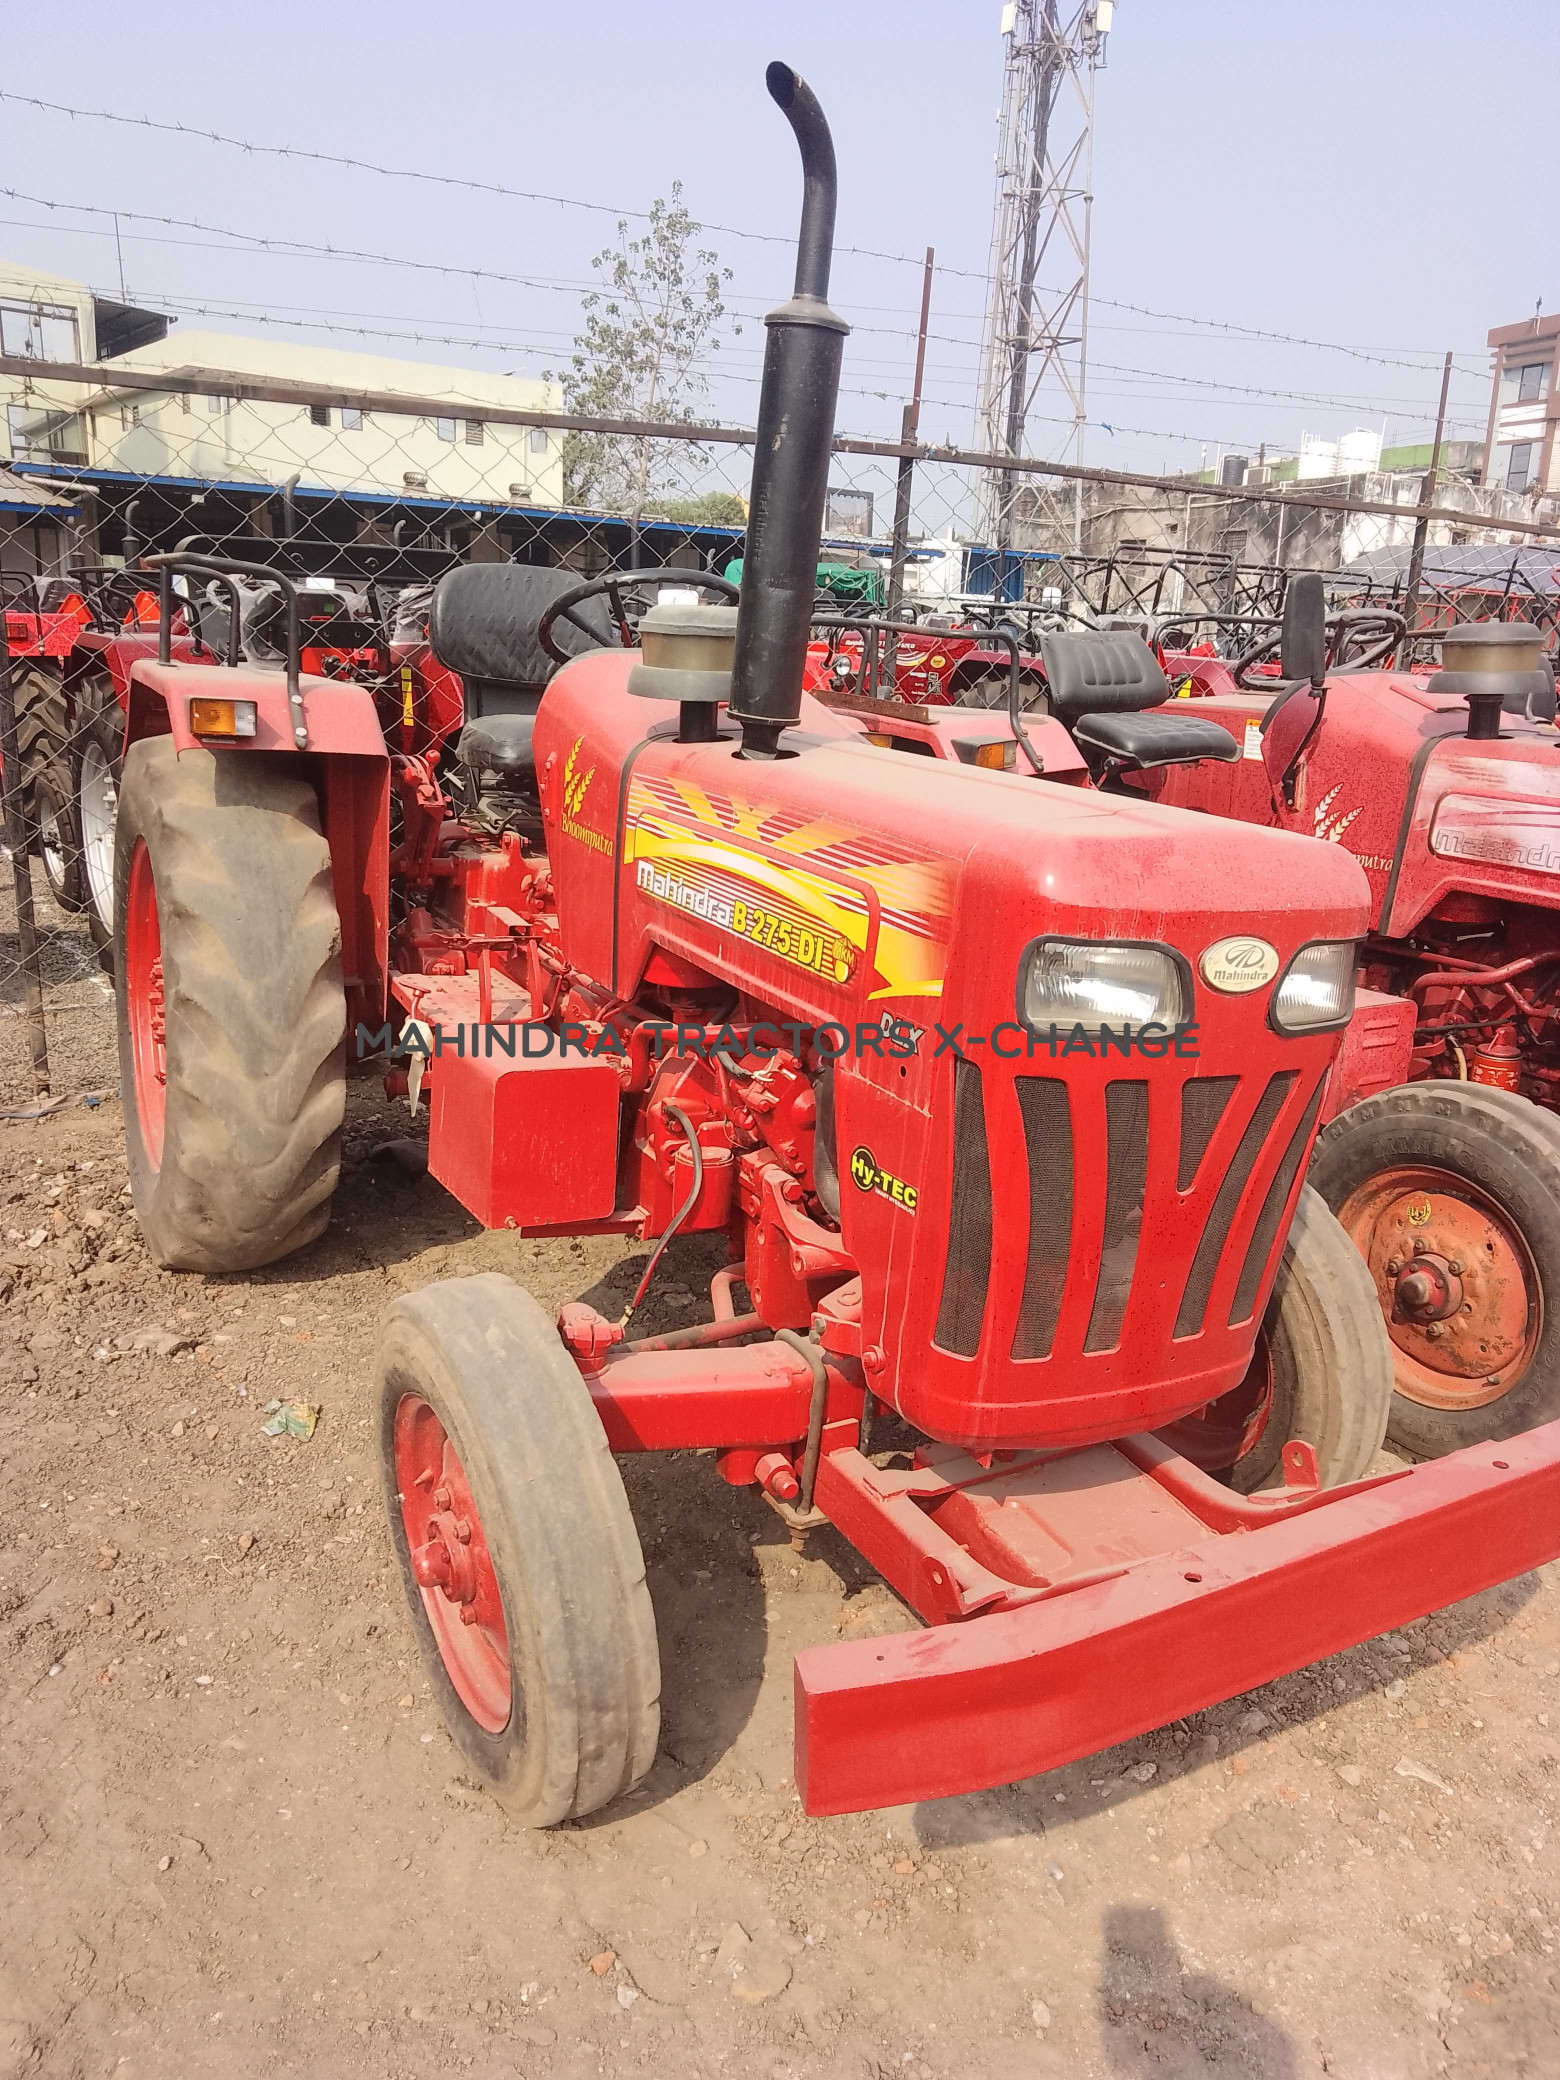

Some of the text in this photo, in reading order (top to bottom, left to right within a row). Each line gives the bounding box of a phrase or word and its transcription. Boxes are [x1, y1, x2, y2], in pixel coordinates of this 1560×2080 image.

[1435, 828, 1560, 870] Mahindr
[636, 859, 825, 972] Mahindra B 275 DI
[1213, 969, 1269, 981] Mahindra
[851, 1154, 917, 1208] Hy-TEC
